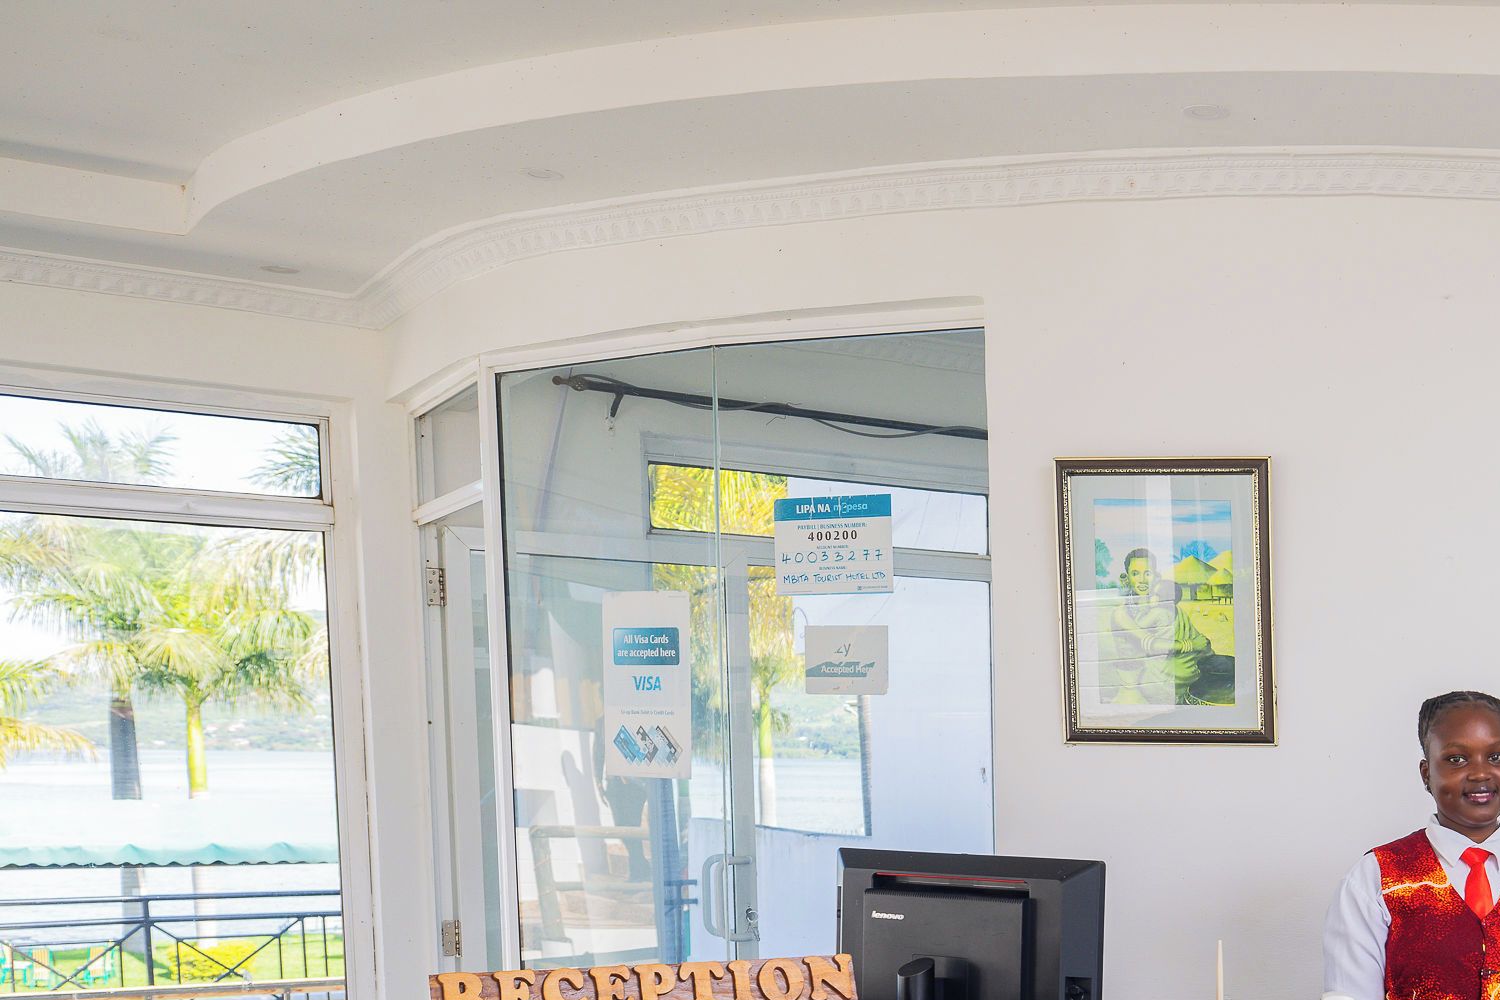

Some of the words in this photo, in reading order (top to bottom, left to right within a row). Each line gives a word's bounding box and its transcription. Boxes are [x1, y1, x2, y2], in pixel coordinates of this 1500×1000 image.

[796, 504, 816, 514] LIPA
[818, 503, 831, 513] NA
[807, 529, 858, 541] 400200
[783, 573, 809, 585] MBITA
[813, 573, 842, 583] TOURIST
[846, 572, 870, 581] HOTEL
[871, 571, 886, 580] LTD
[623, 634, 633, 644] All
[633, 634, 649, 644] Visa
[649, 634, 669, 644] Cards
[629, 648, 659, 659] accepted
[660, 648, 676, 657] here
[820, 664, 854, 675] Accepted
[632, 675, 662, 691] VISA
[871, 910, 905, 920] lenovo
